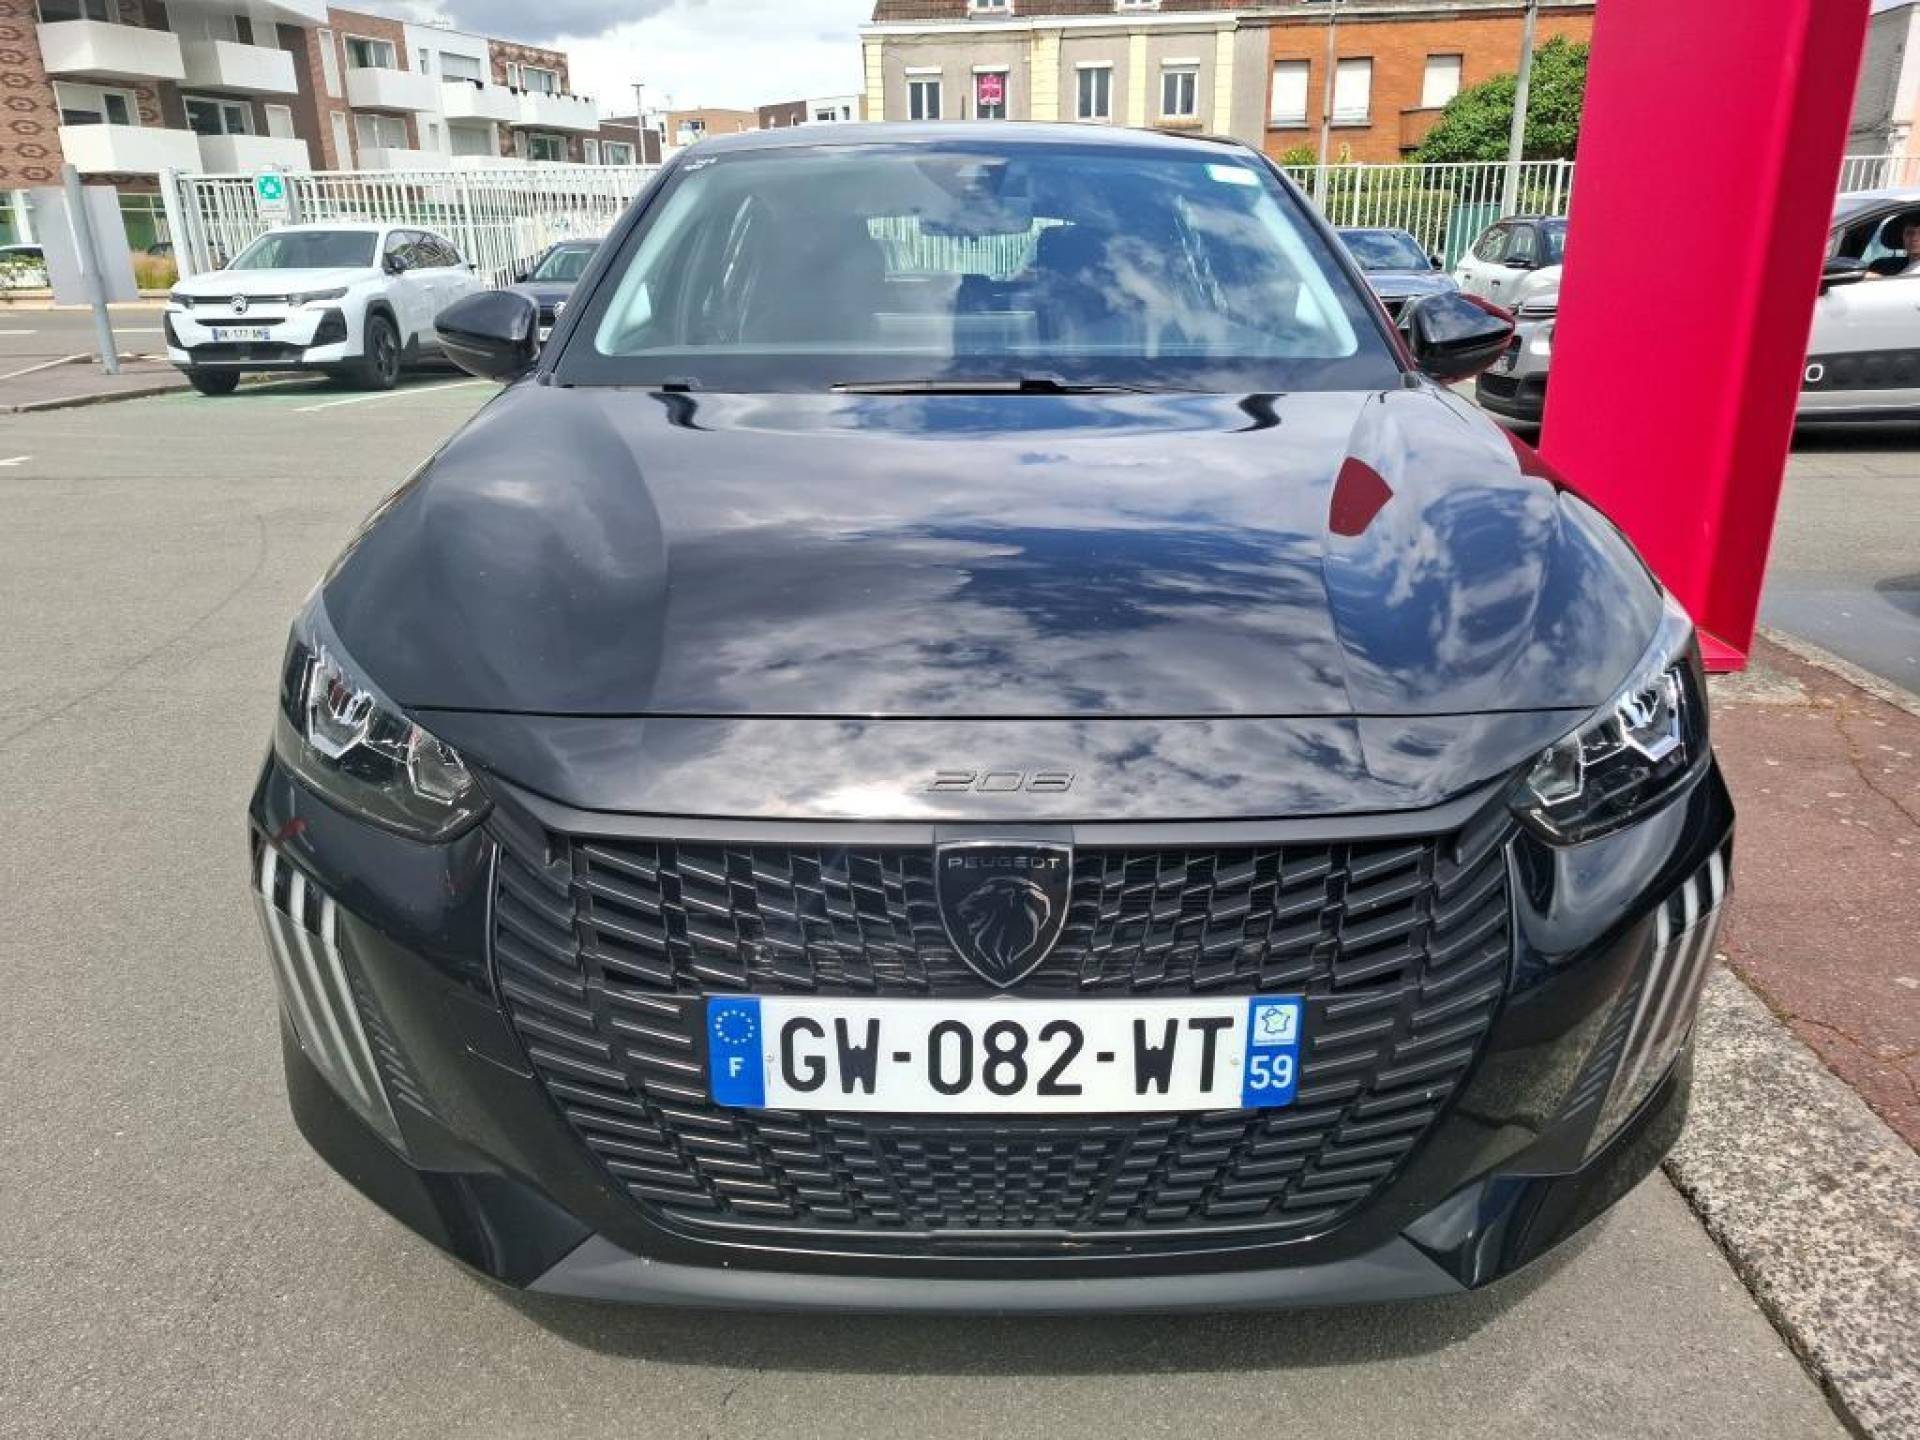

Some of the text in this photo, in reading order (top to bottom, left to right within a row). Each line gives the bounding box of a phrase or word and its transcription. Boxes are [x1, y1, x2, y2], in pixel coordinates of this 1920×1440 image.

[926, 769, 1078, 793] 208
[948, 856, 1061, 870] PEUGEOT
[728, 1056, 745, 1078] F
[780, 1016, 1235, 1096] GW-082-WT
[1249, 1054, 1293, 1090] 59
